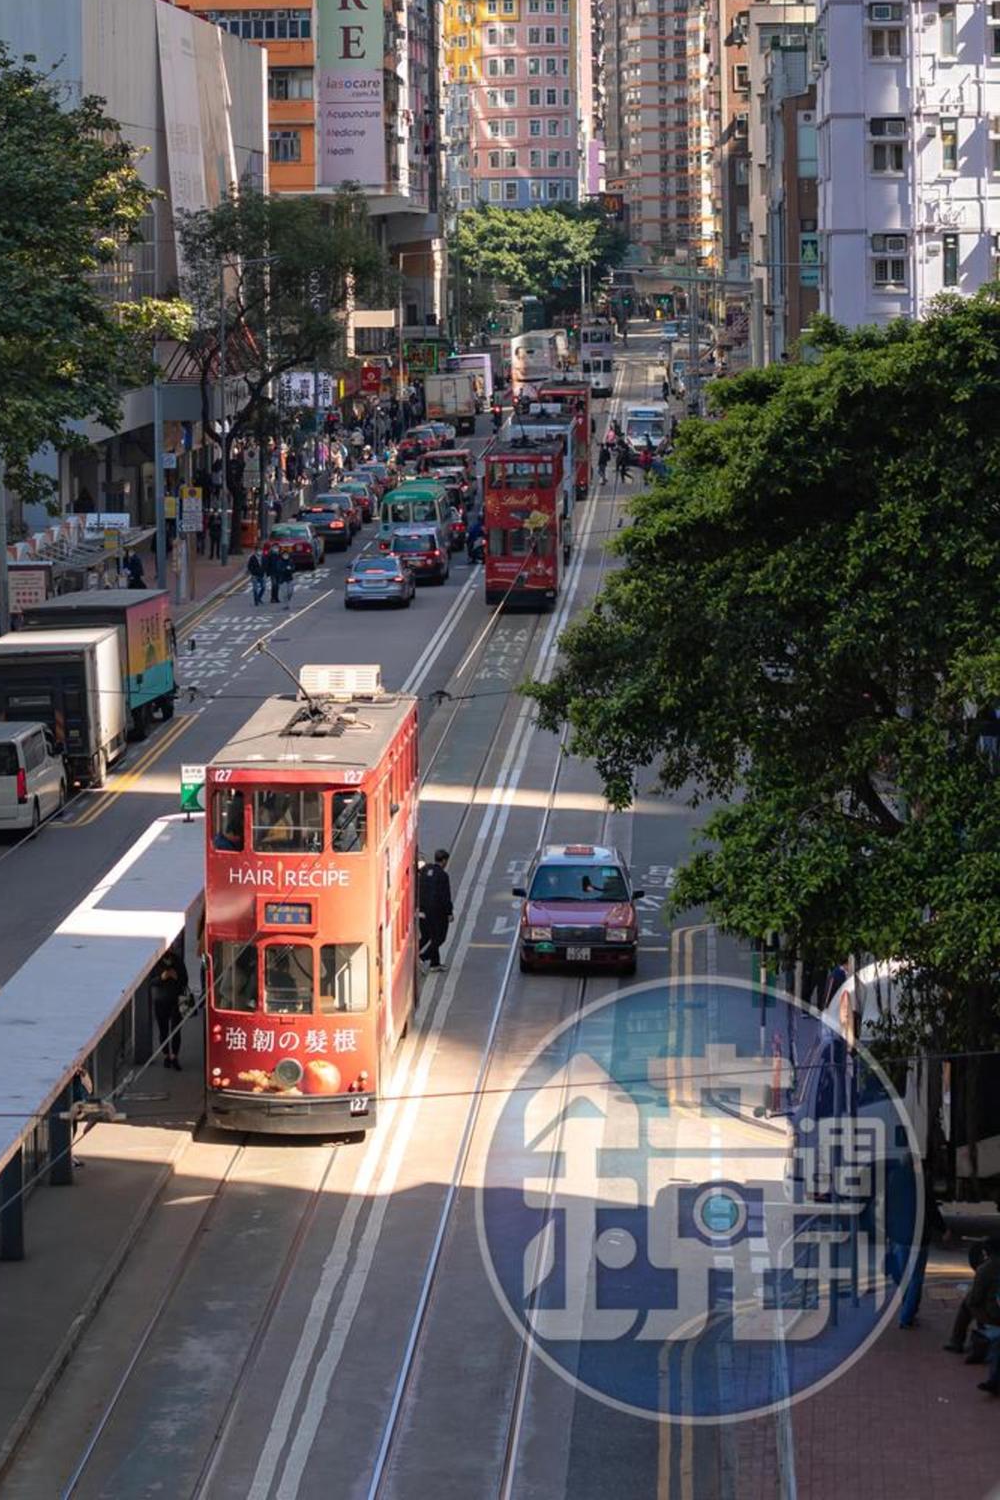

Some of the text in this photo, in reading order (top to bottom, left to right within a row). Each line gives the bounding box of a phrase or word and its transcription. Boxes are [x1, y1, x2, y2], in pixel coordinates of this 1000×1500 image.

[327, 109, 381, 118] Acupuncture
[327, 128, 366, 137] Medicine
[327, 147, 354, 156] Health
[215, 770, 232, 782] 127
[344, 772, 364, 783] 127
[229, 868, 350, 887] HAIR RECIPE
[349, 1097, 369, 1111] 127
